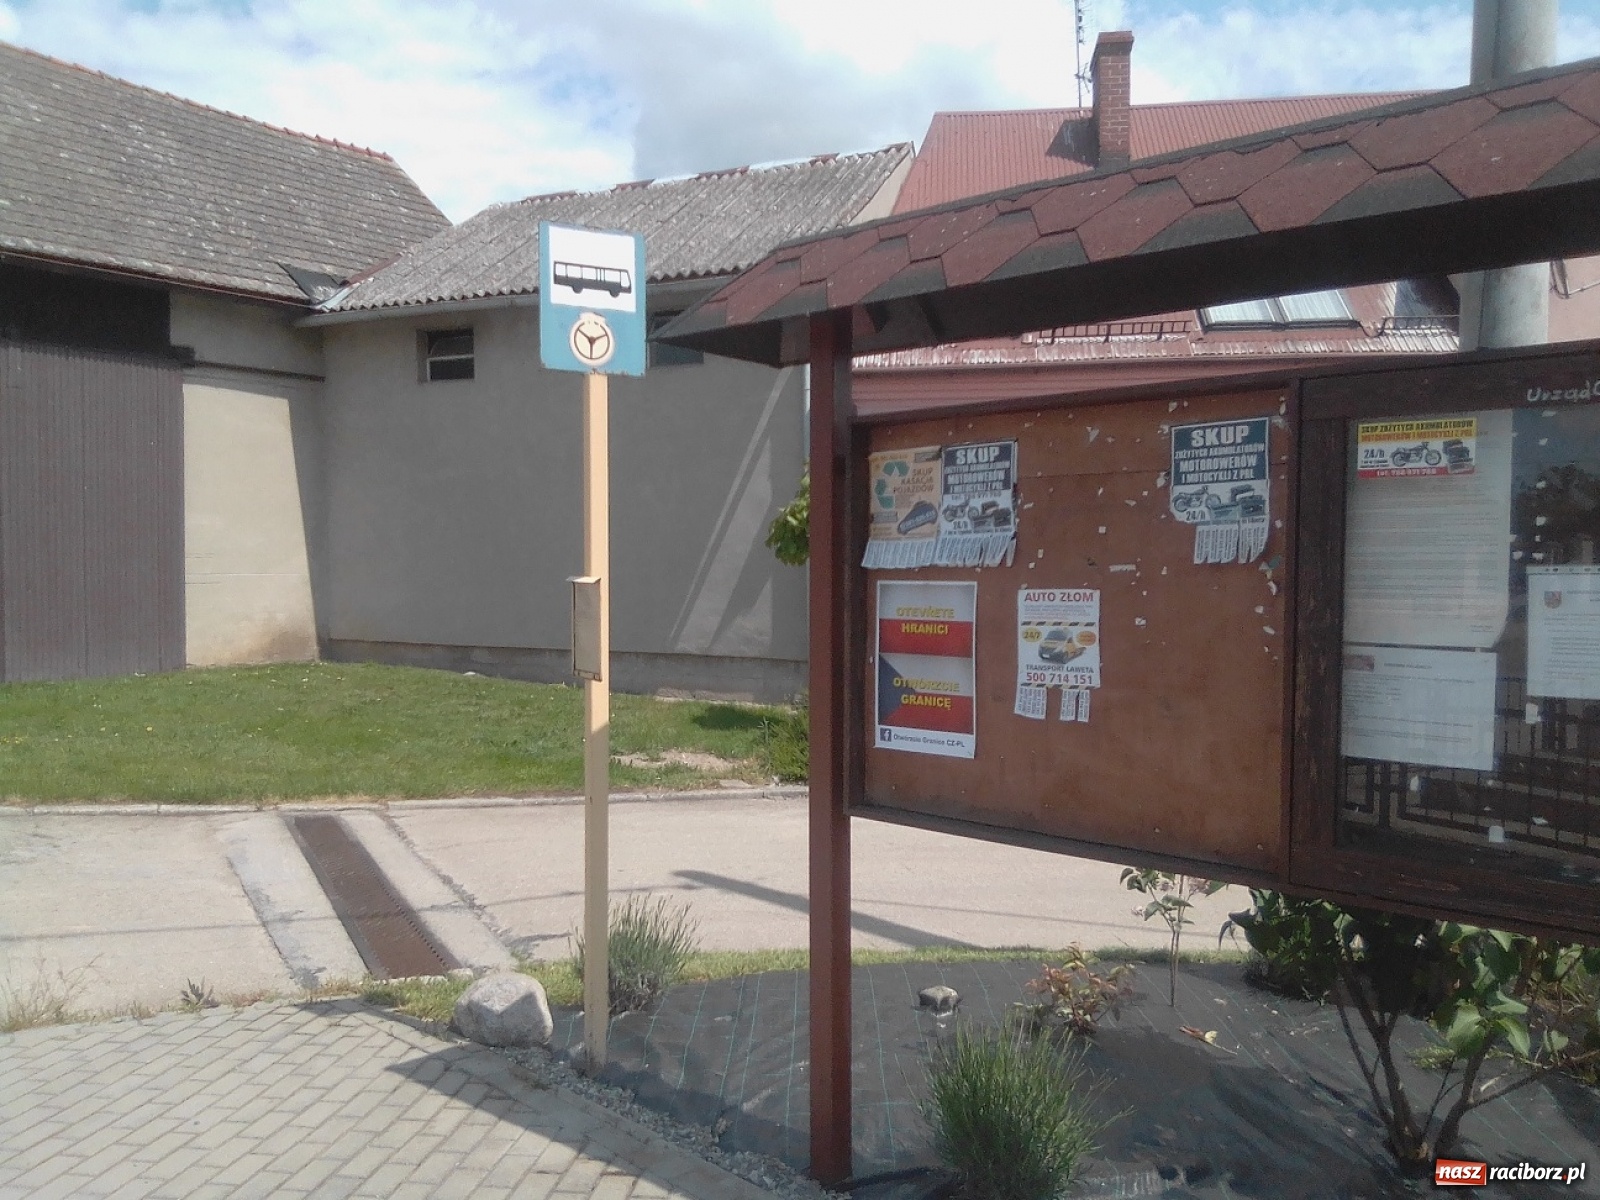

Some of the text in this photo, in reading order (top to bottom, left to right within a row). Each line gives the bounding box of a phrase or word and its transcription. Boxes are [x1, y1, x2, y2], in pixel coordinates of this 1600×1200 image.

[1190, 425, 1249, 448] SKUP
[955, 446, 1000, 464] SKUP
[1179, 453, 1258, 473] MOTOROWERÓW
[1024, 592, 1094, 602] AUTO ZŁOM
[901, 622, 949, 635] HRANICI
[1024, 631, 1040, 640] 24/7
[1026, 664, 1094, 674] TRANSPORT ŁAWETA
[1026, 672, 1093, 685] 500 714 151
[901, 694, 952, 711] GRANICĘ
